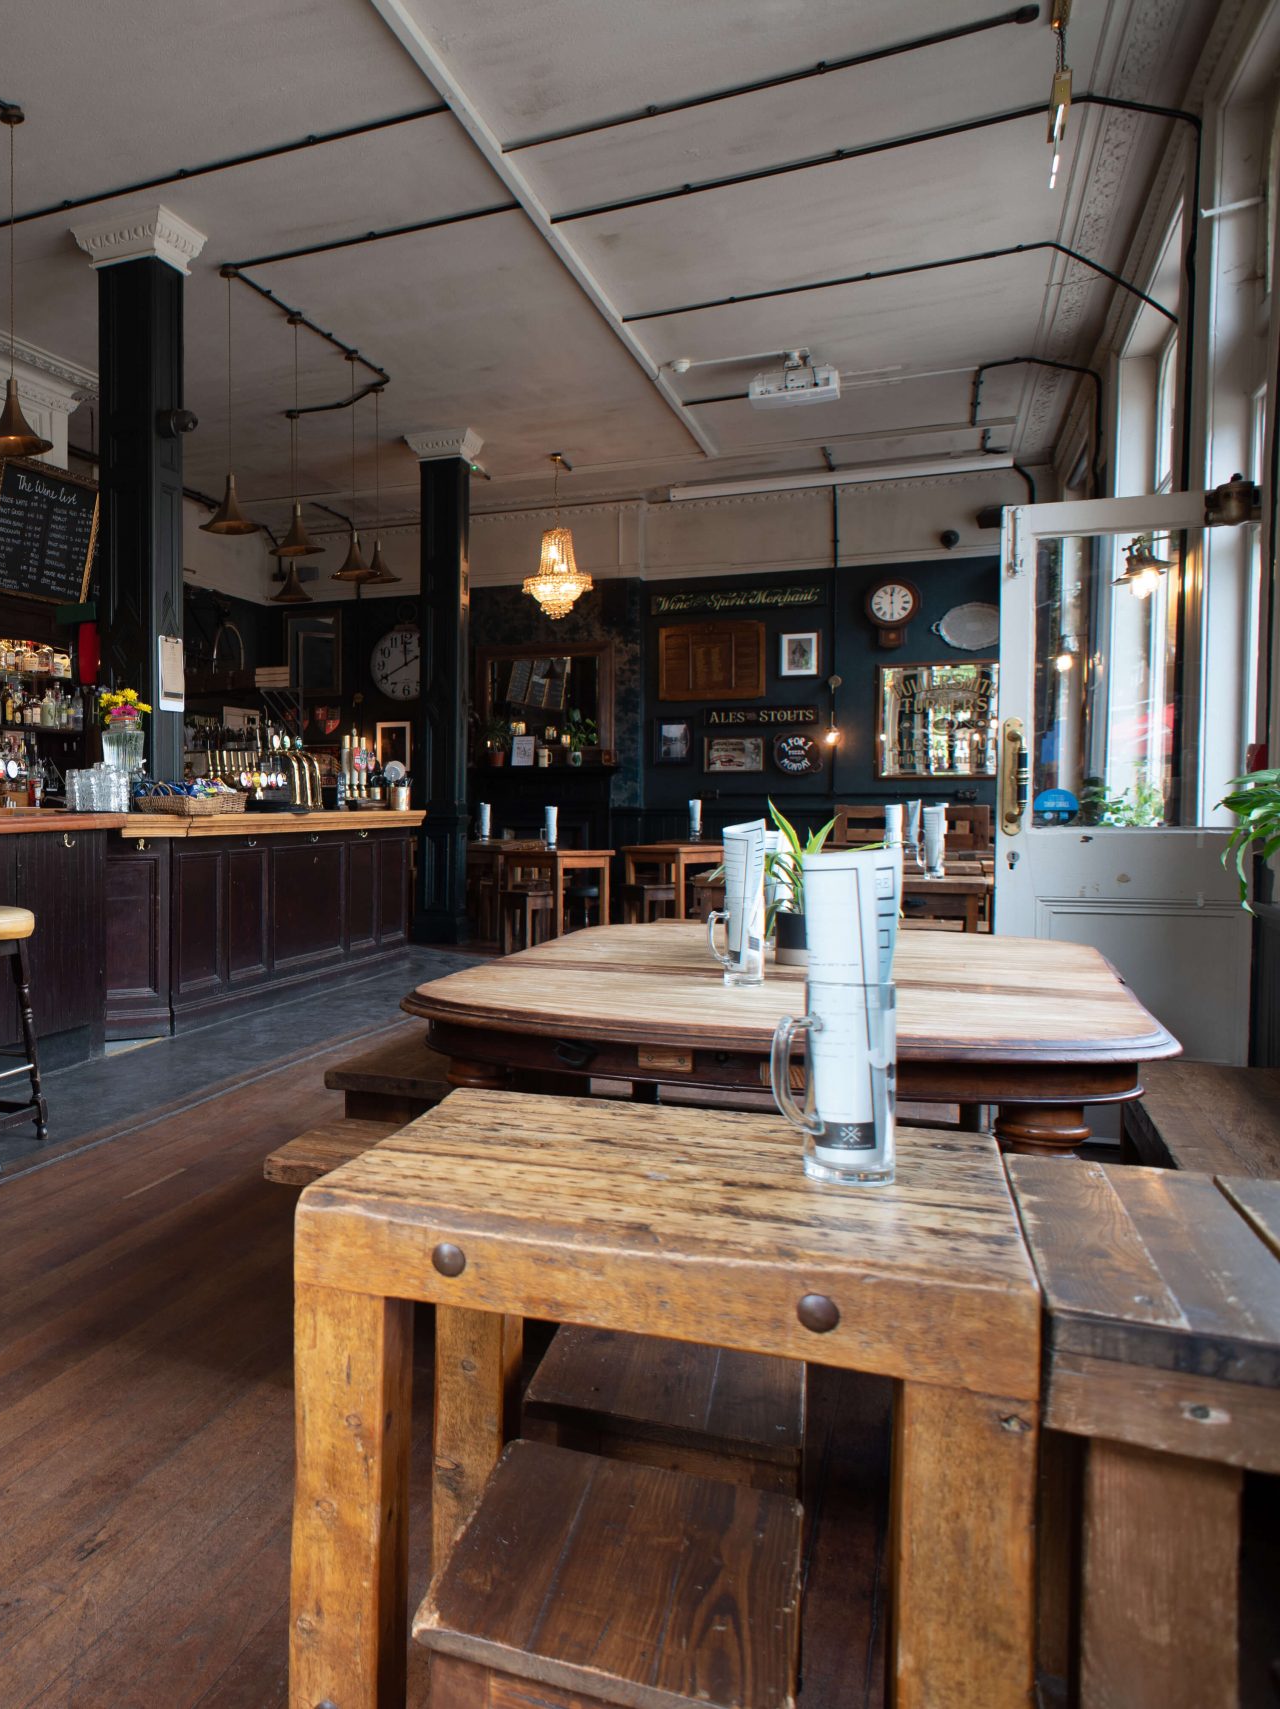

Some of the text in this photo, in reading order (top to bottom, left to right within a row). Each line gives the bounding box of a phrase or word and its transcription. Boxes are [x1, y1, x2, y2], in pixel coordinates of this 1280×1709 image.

[16, 473, 34, 493] The
[35, 479, 57, 499] Wine
[655, 594, 691, 612] Wine
[707, 592, 746, 610] Spirit
[748, 588, 820, 607] Merchant
[390, 637, 398, 649] 11
[380, 646, 391, 659] 10
[377, 660, 385, 671] 9
[390, 682, 398, 694] 7
[402, 684, 410, 697] 6
[709, 711, 745, 723] ALES
[759, 709, 814, 722] STOUTS
[787, 737, 805, 747] FOR
[781, 758, 811, 772] MONDAY
